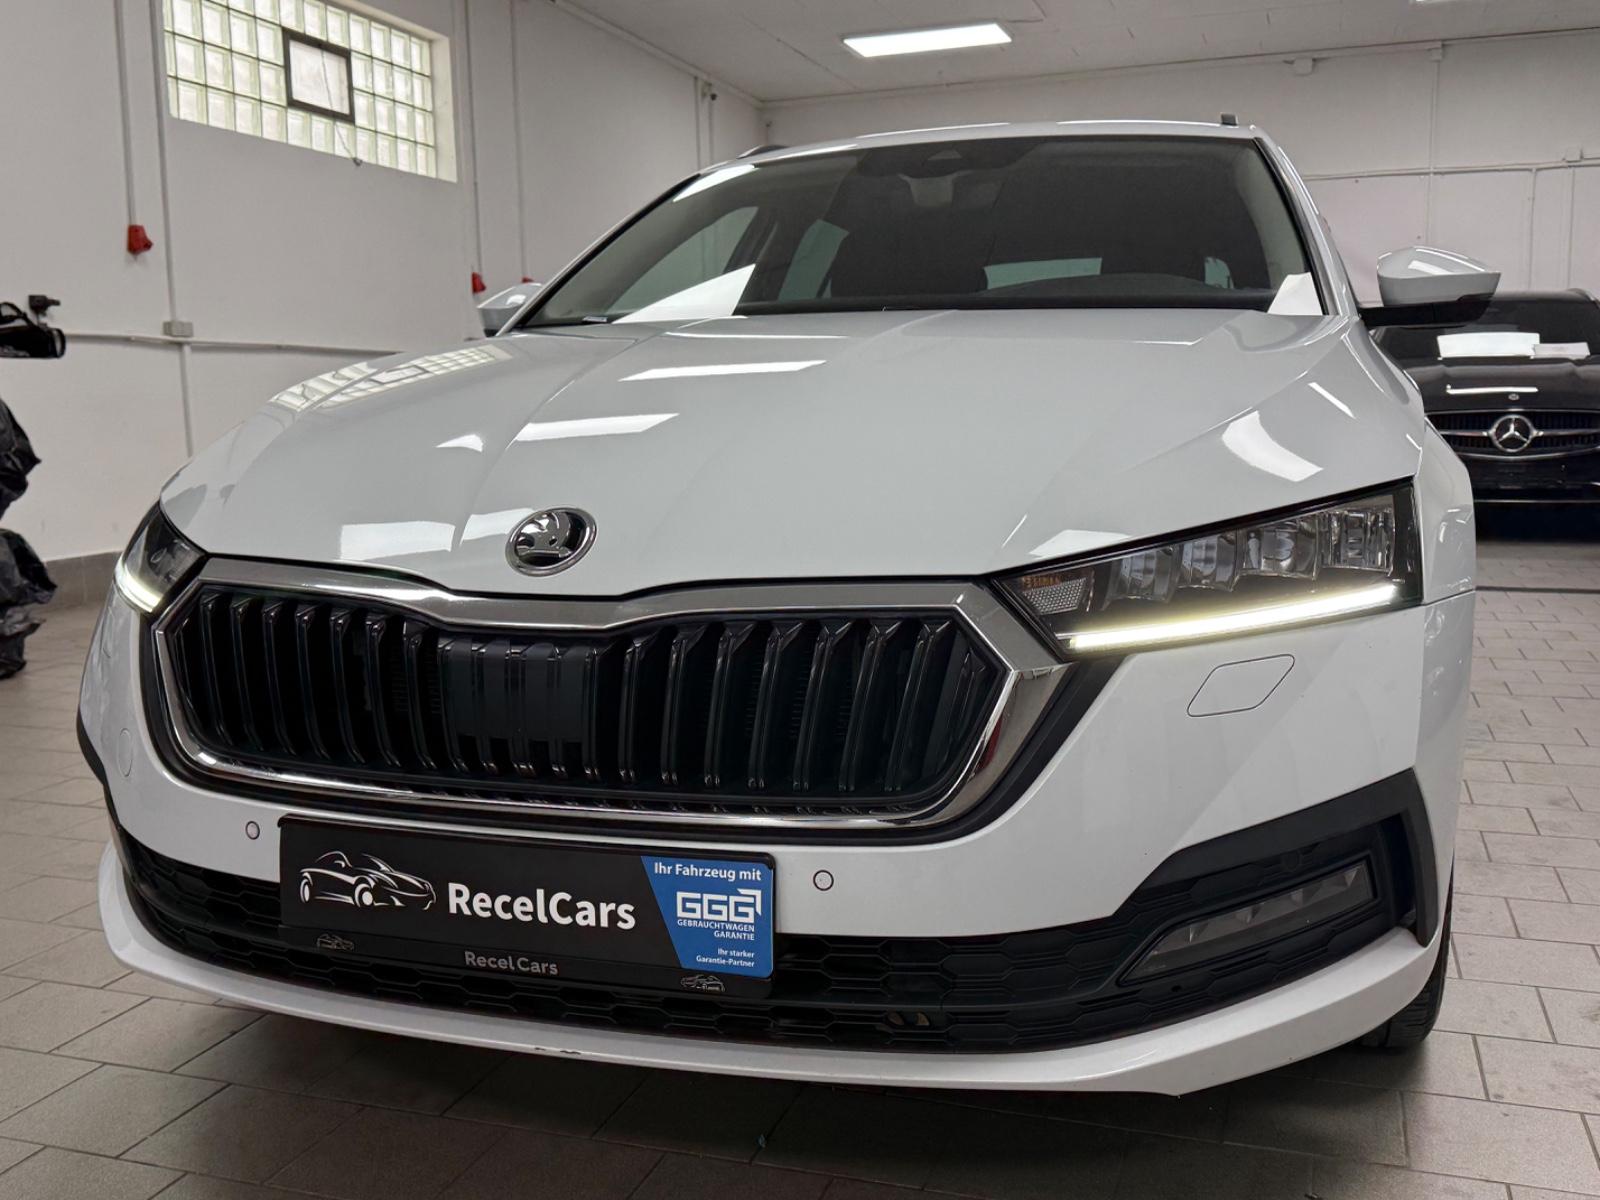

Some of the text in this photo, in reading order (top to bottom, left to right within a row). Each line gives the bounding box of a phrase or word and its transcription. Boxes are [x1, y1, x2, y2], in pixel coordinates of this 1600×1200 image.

[654, 862, 762, 882] Ihr Fahrzeug mit
[448, 882, 636, 930] RecelCars
[676, 891, 755, 923] GGG
[677, 918, 755, 932] GEBRAUCHTWAGEN
[713, 930, 755, 941] GARANTIE
[695, 955, 755, 967] Garantie-Partner
[717, 948, 755, 958] Ihr starker
[464, 950, 558, 975] Recel Cars
